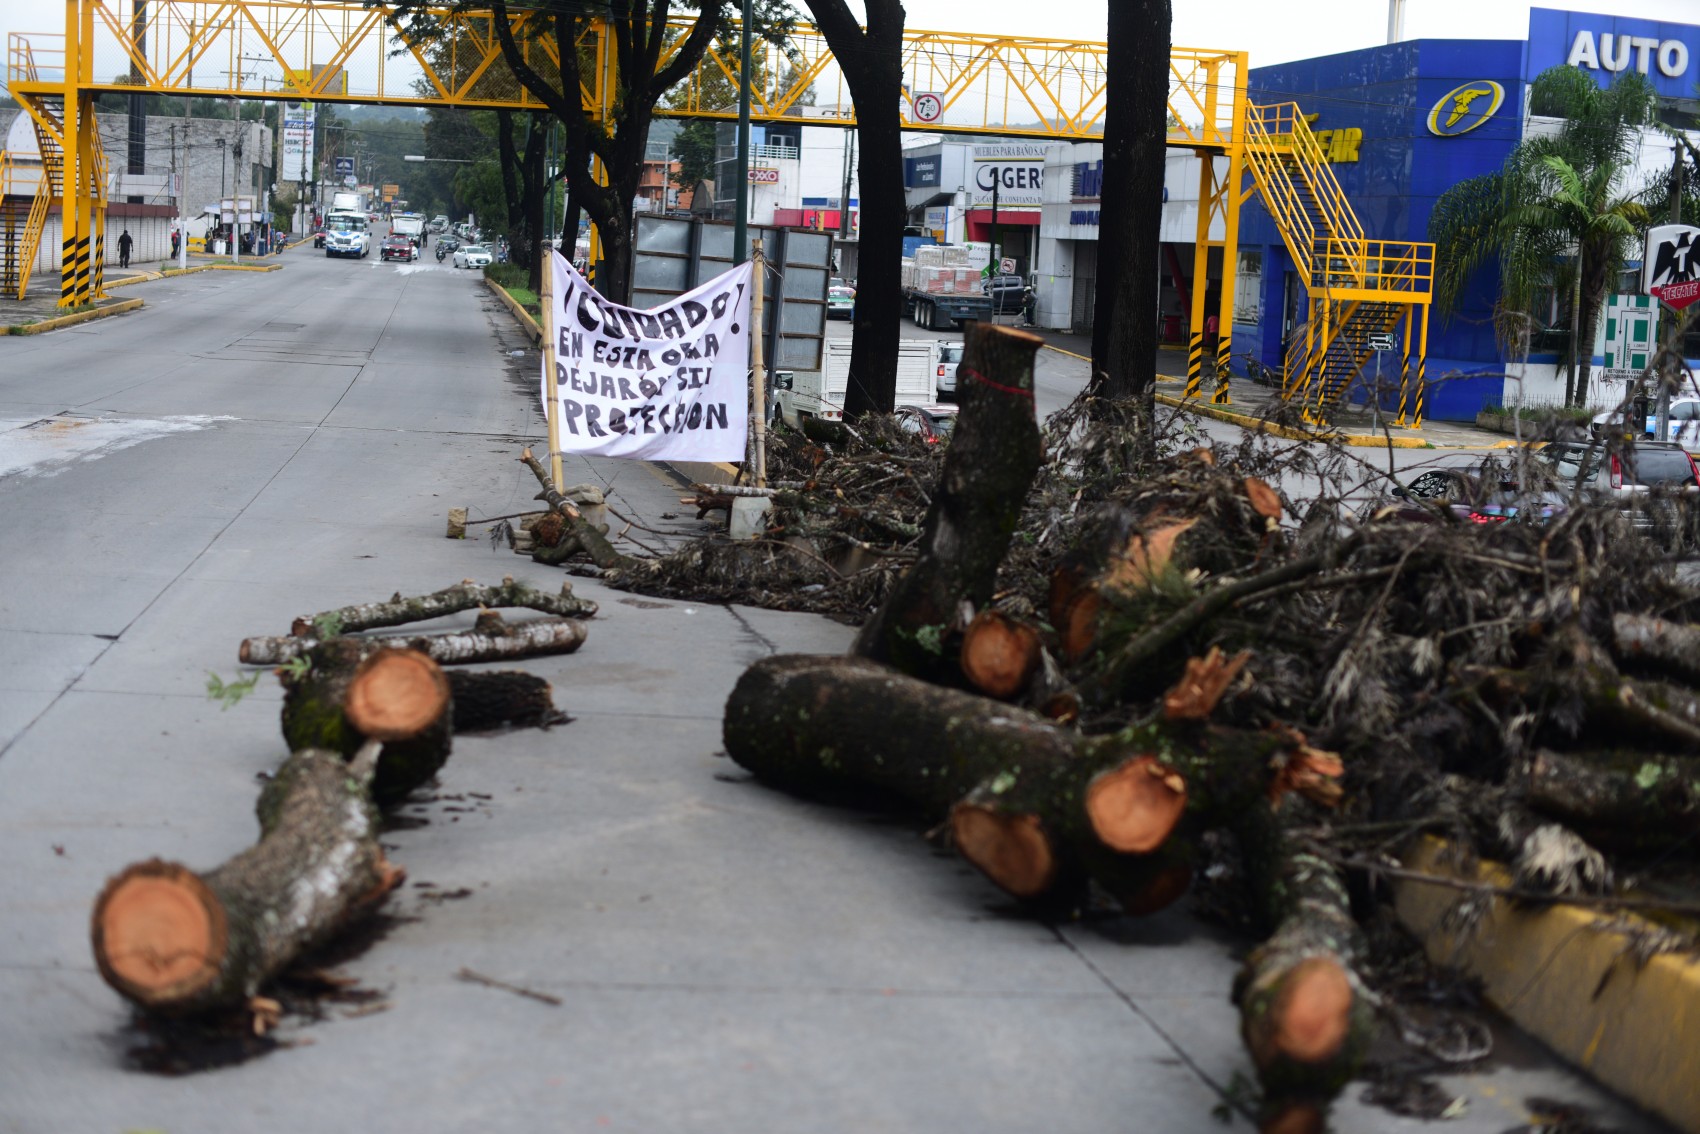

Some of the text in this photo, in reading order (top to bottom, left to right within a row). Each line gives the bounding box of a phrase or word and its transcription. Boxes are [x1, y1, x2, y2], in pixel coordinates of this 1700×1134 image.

[1567, 30, 1689, 77] AUTO
[975, 146, 1000, 157] MUEBLES
[1001, 146, 1017, 156] PARA
[1017, 144, 1034, 156] BAÑO
[747, 170, 778, 182] OXXO
[1002, 167, 1044, 190] GER
[1661, 283, 1699, 301] TECATE
[559, 326, 583, 358] EN
[593, 340, 657, 373] ESTA
